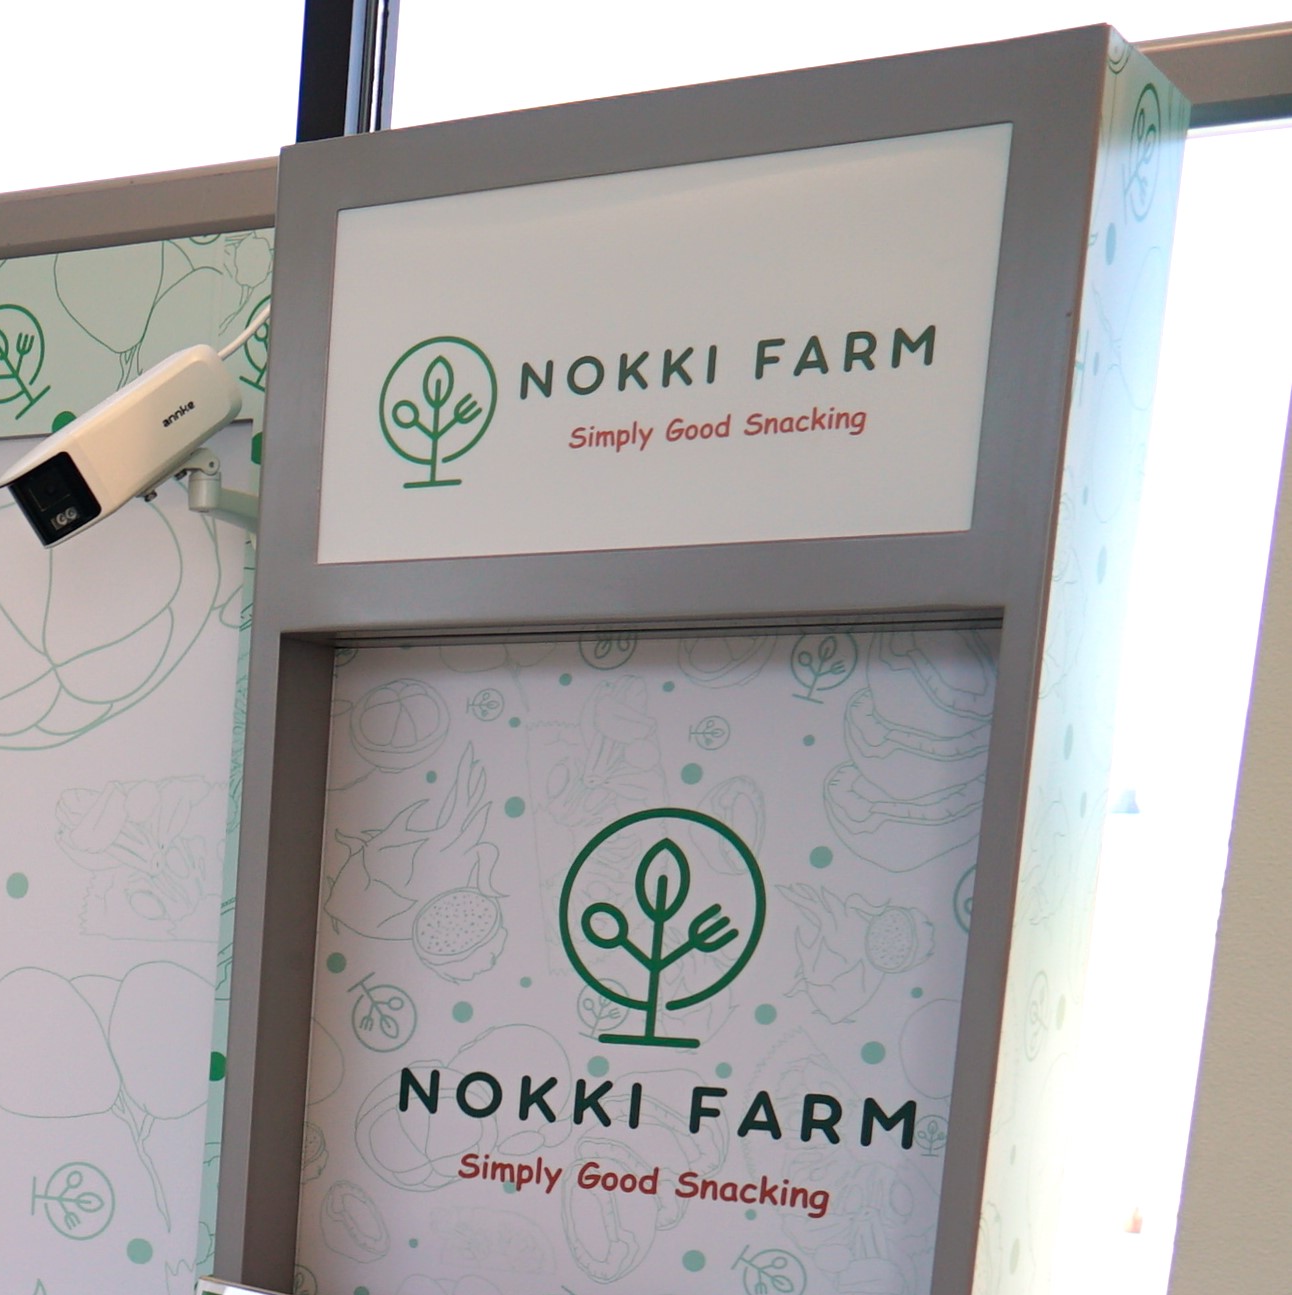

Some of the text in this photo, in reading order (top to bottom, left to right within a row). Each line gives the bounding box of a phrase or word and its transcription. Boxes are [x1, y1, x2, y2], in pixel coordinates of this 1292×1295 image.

[519, 325, 937, 400] NOKKI FARM
[162, 401, 195, 427] annke
[568, 408, 867, 453] Simply Good Snacking
[398, 1067, 918, 1150] NOKKI FARM
[458, 1153, 830, 1218] Simply Good Snacking
